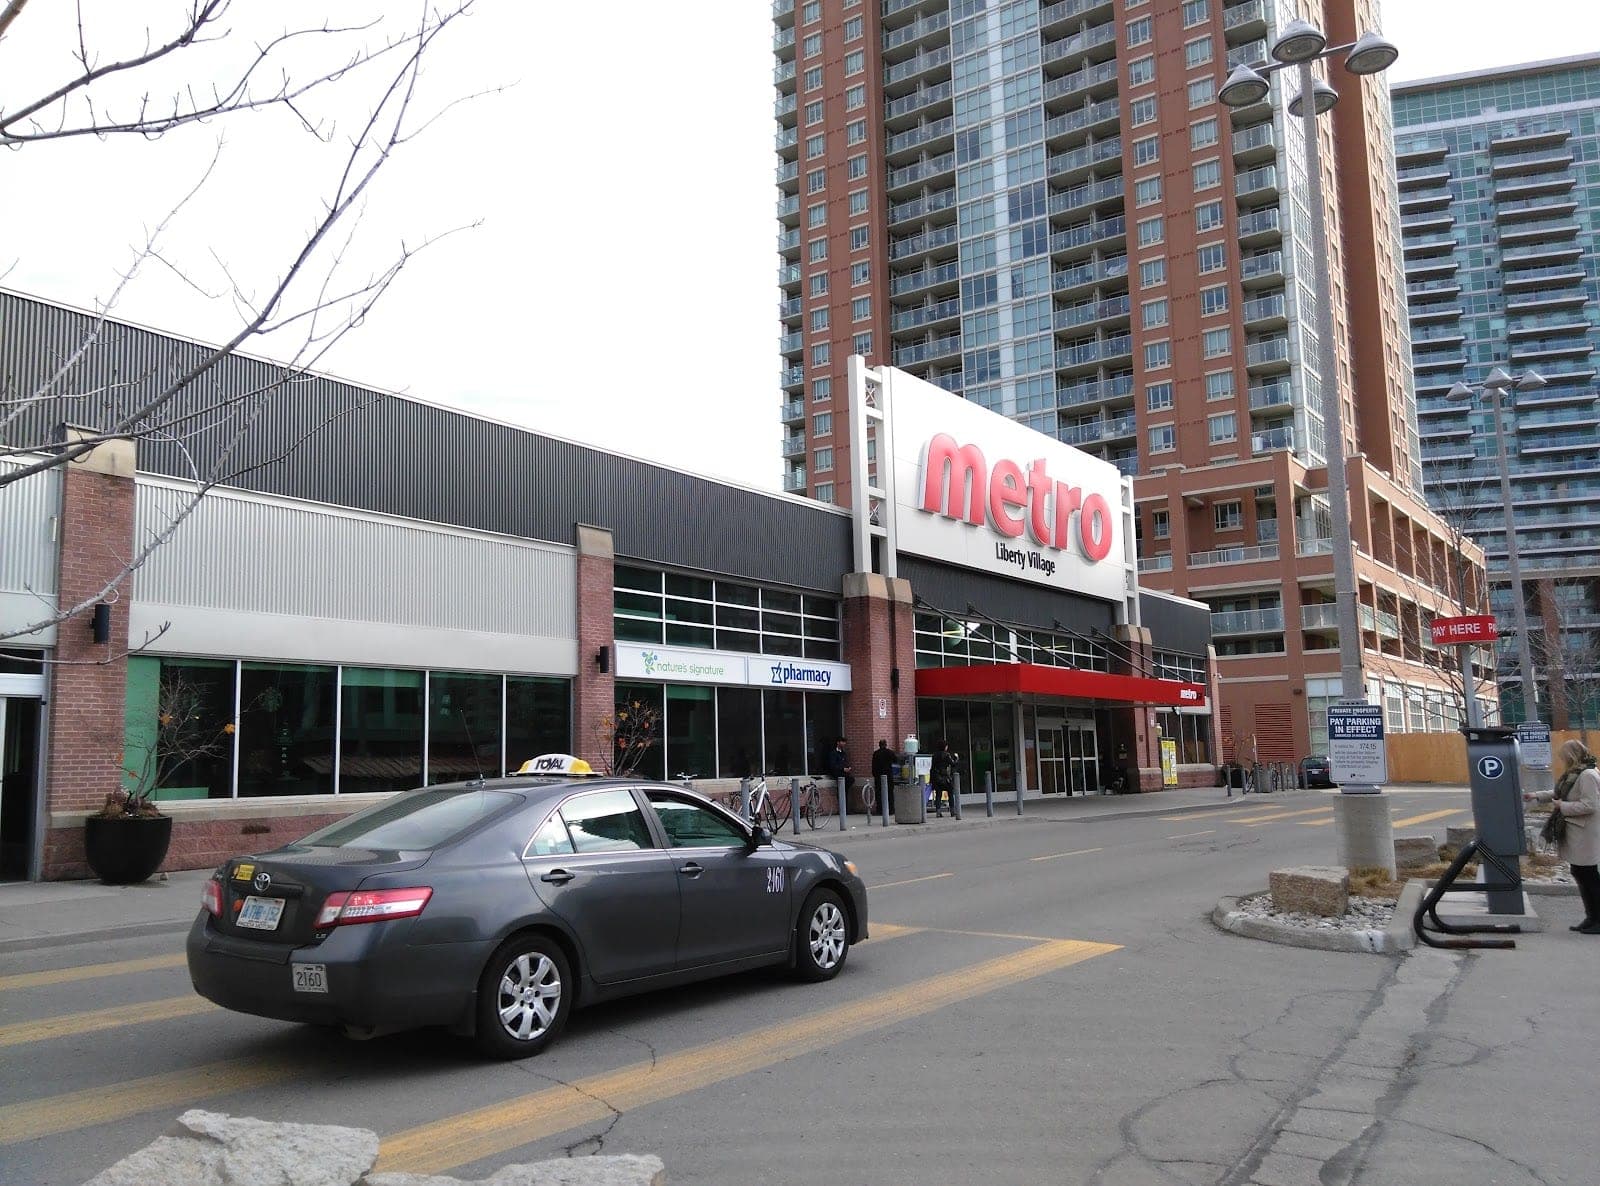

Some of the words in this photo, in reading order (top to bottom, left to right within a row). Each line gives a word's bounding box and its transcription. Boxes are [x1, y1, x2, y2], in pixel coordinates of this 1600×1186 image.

[918, 433, 1112, 561] metro
[995, 542, 1026, 570] Liberty
[1027, 551, 1056, 576] Village
[1432, 624, 1446, 637] PAY
[1449, 623, 1481, 635] HERE
[657, 662, 688, 673] nature's
[689, 664, 724, 676] signature
[783, 663, 831, 686] pharmacy
[1330, 717, 1344, 726] PAY
[1346, 717, 1381, 726] PARKING
[1335, 725, 1344, 733] IN
[1346, 725, 1377, 733] EFFECT
[767, 866, 785, 893] 2160
[295, 971, 322, 987] 2160
